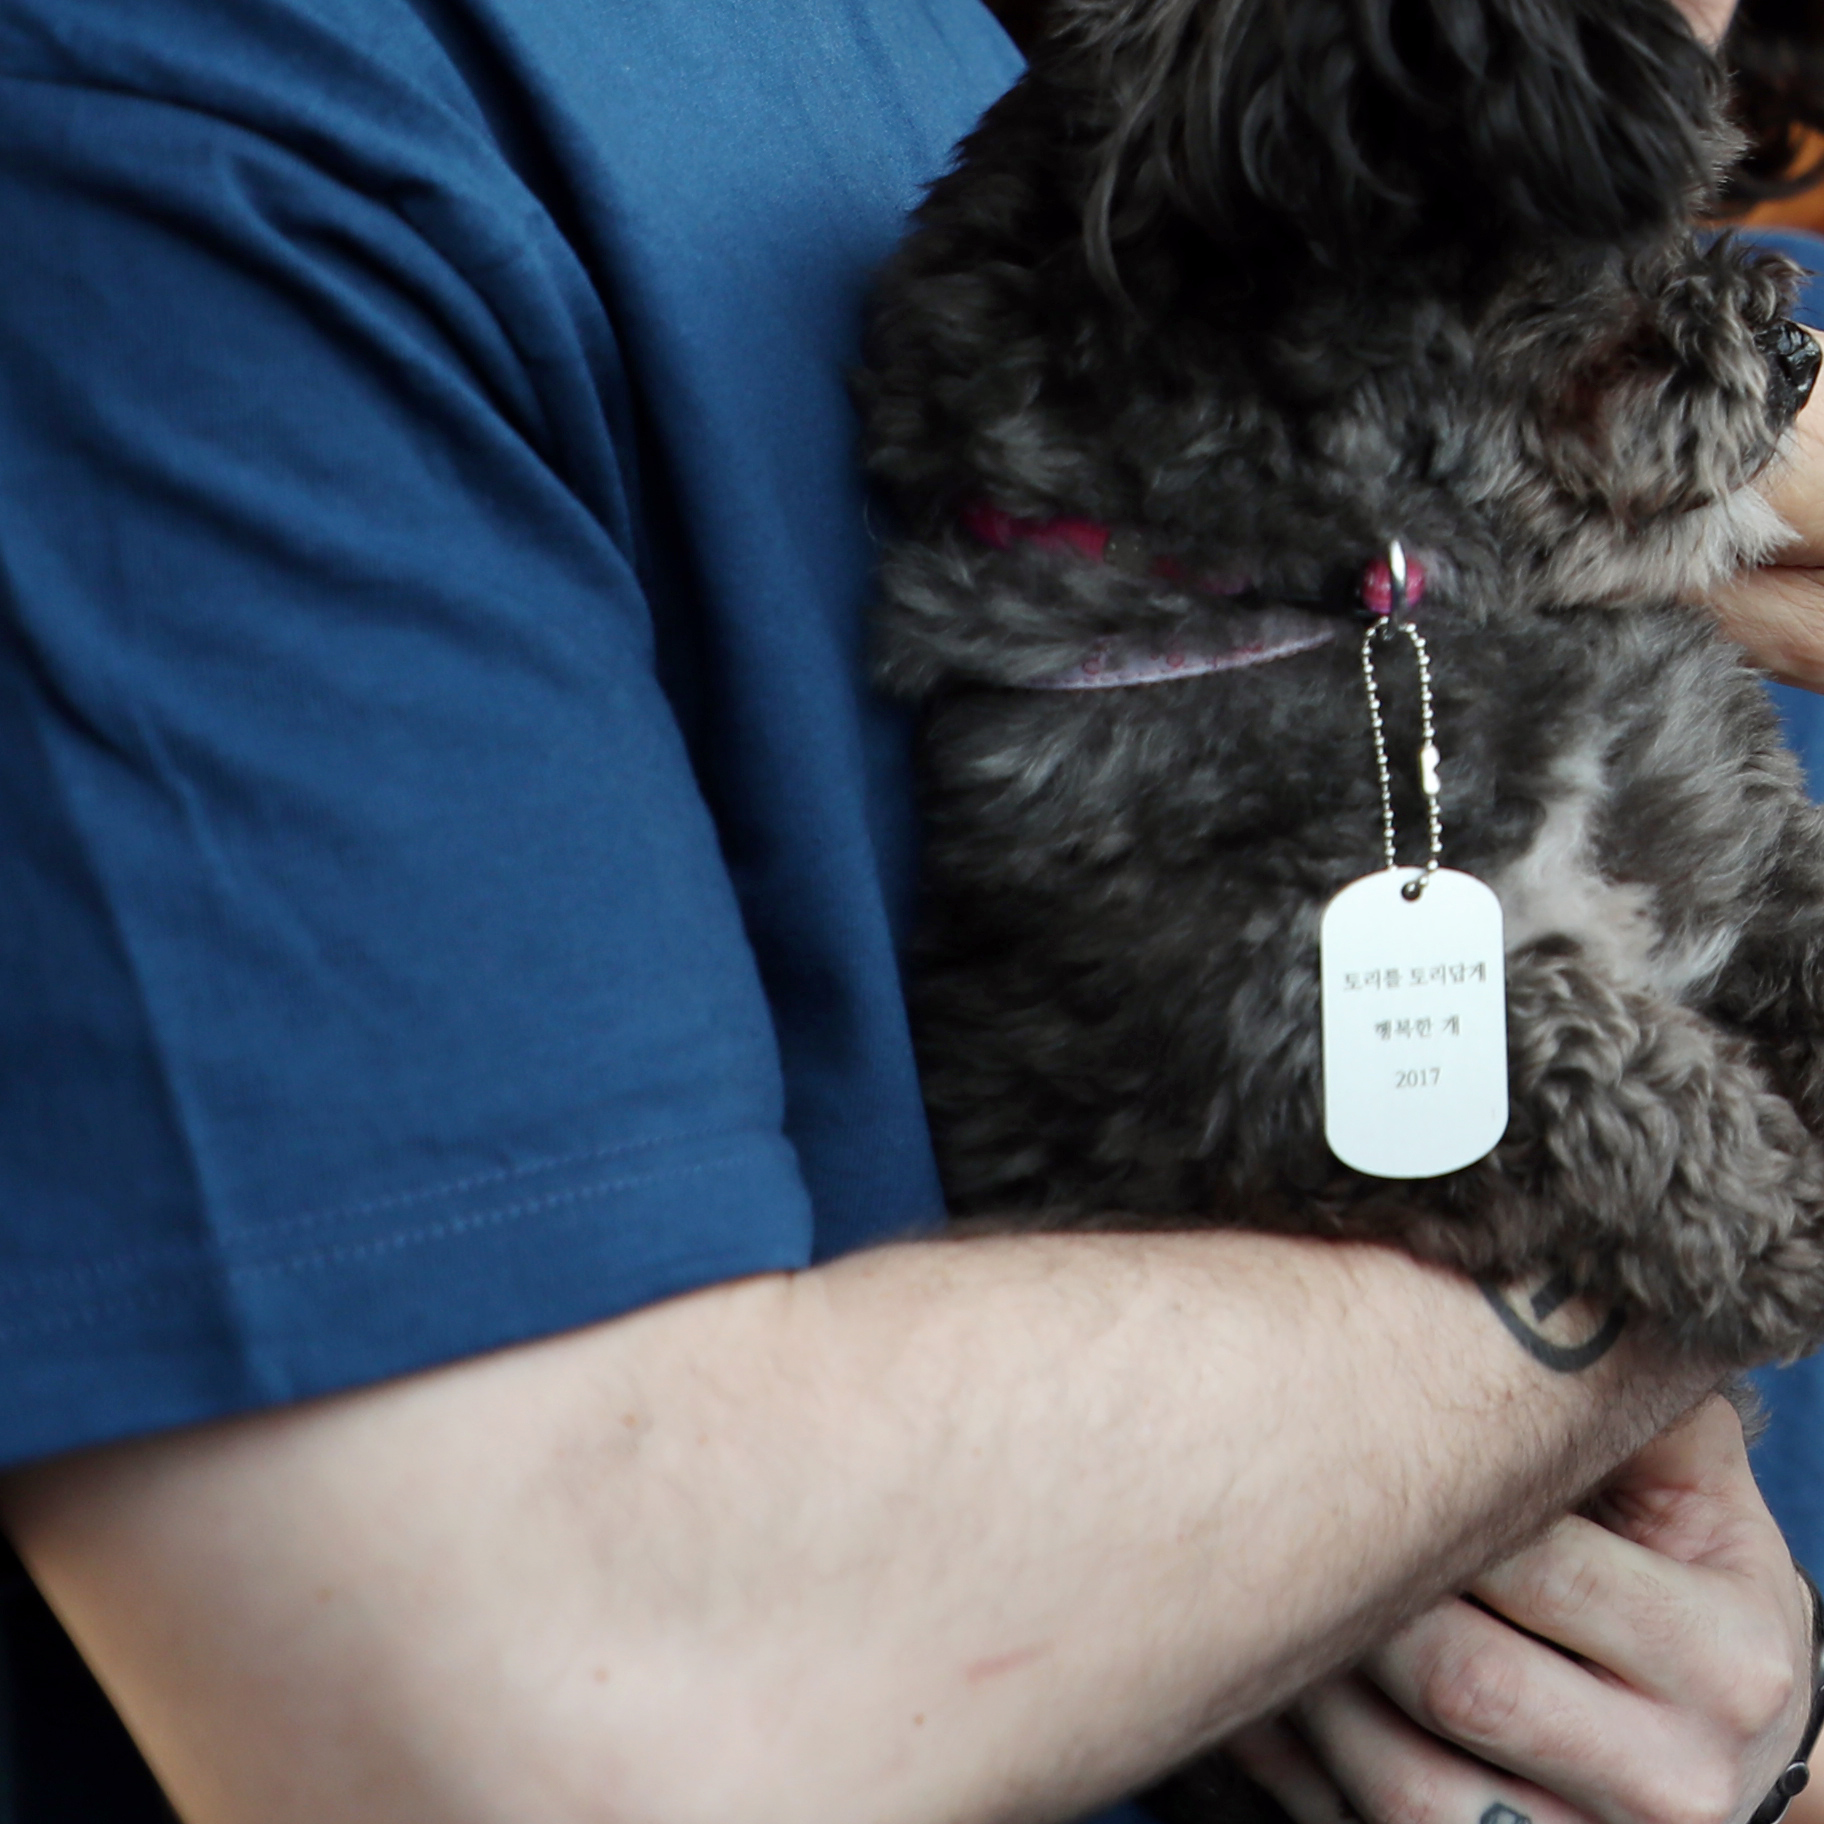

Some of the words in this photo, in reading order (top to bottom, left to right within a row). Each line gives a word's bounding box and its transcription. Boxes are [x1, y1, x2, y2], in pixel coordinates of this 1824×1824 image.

[1345, 969, 1402, 990] 토리를
[1410, 962, 1486, 986] 토리답게
[1375, 1018, 1432, 1040] 행복한
[1443, 1016, 1460, 1037] 개
[1396, 1067, 1441, 1088] 2017
